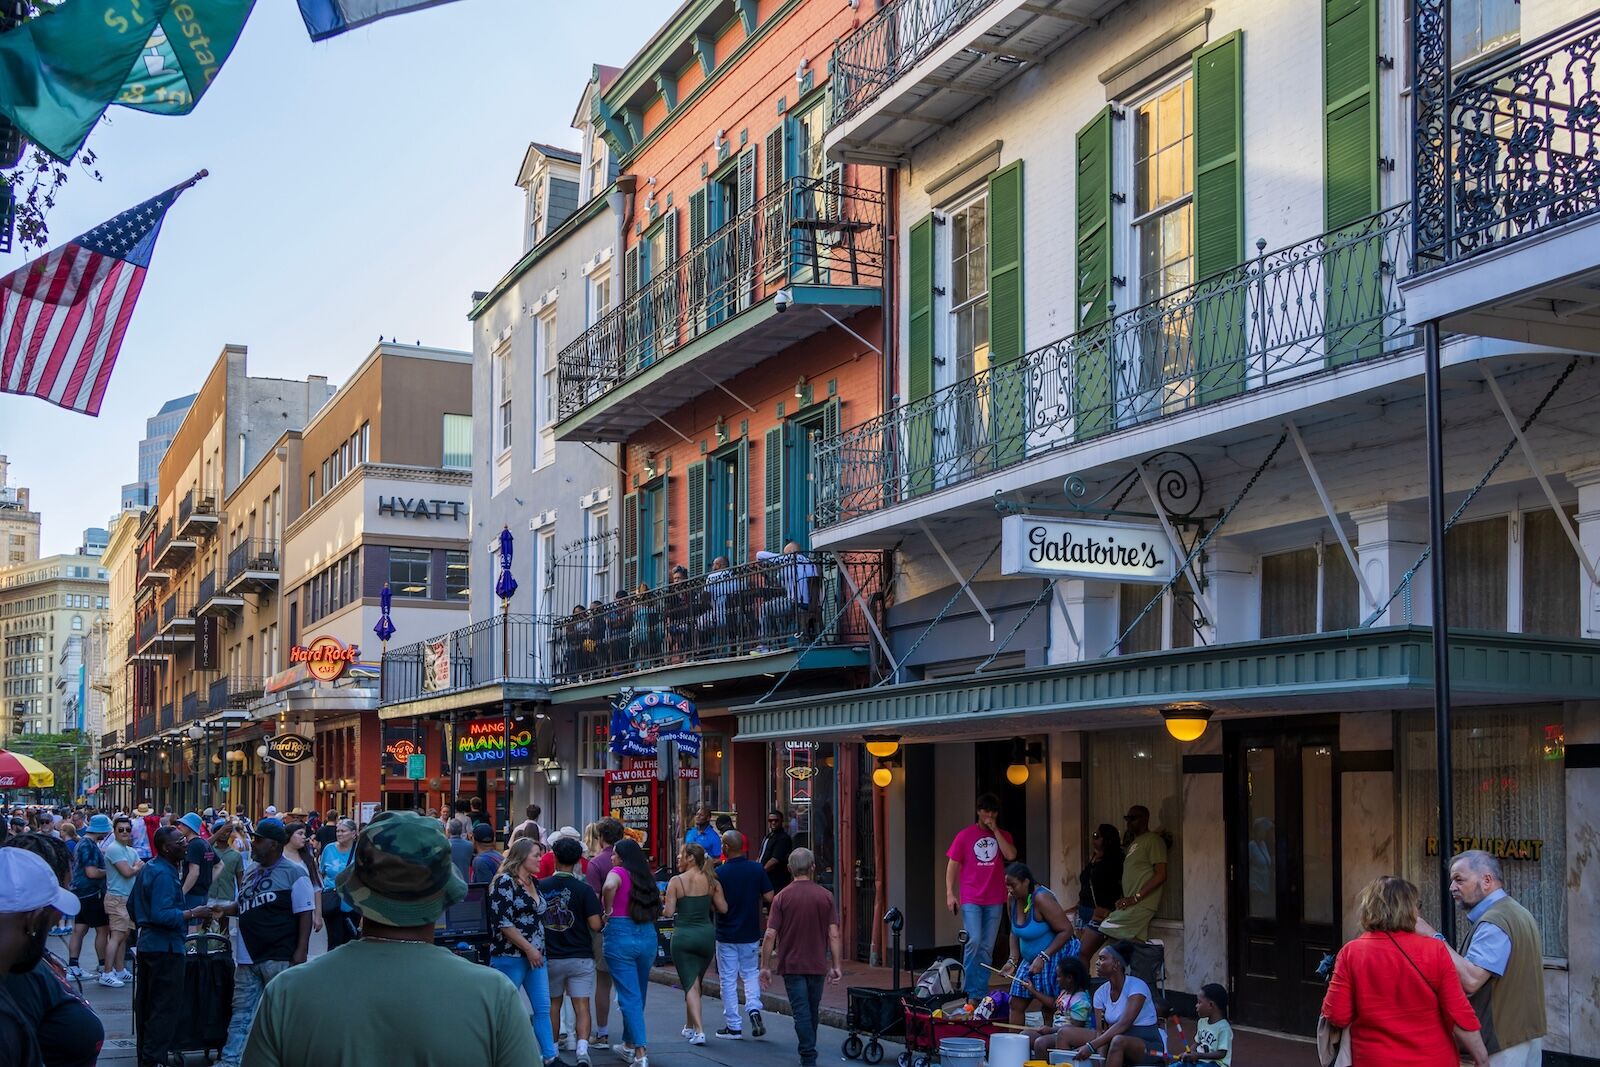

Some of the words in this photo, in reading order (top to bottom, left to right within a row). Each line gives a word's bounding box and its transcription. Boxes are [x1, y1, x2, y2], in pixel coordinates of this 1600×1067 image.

[378, 495, 464, 521] HYATT
[1028, 526, 1164, 569] Galatoire's
[290, 645, 323, 662] Hard
[324, 644, 357, 664] Rock
[627, 693, 691, 717] NOLA
[270, 741, 292, 751] Hard
[291, 742, 312, 753] Rock
[404, 745, 422, 754] Rok
[465, 747, 529, 762] DAIQURIS
[612, 771, 630, 781] NEW
[622, 806, 649, 816] SEAFOOD
[1425, 836, 1544, 861] RSTAURANT
